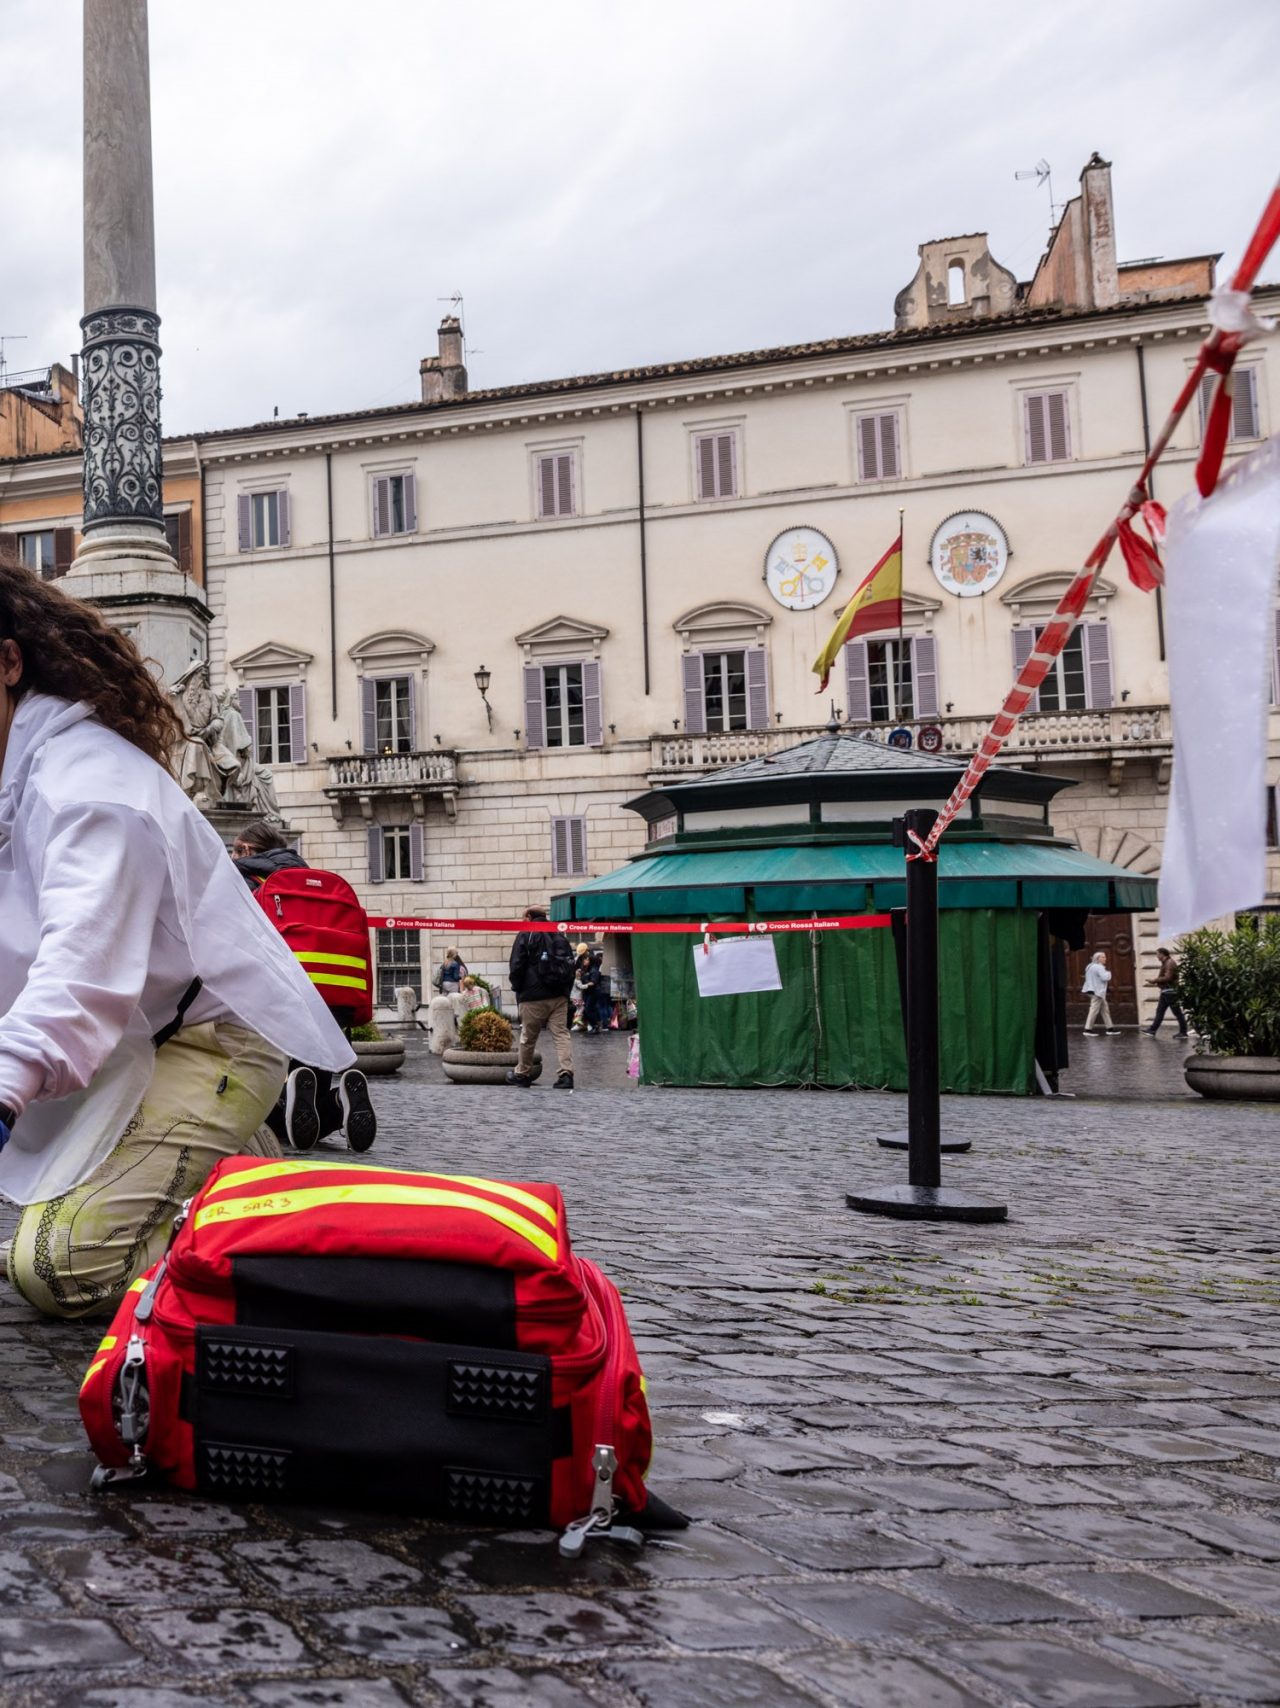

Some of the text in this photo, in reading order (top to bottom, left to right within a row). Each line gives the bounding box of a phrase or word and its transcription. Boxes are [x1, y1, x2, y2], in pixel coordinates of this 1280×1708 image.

[396, 919, 455, 929] Croce Rossa Italiana
[569, 923, 633, 931] Croce Rossa Italiana
[813, 920, 840, 928] Italiana
[242, 1199, 275, 1212] SAR
